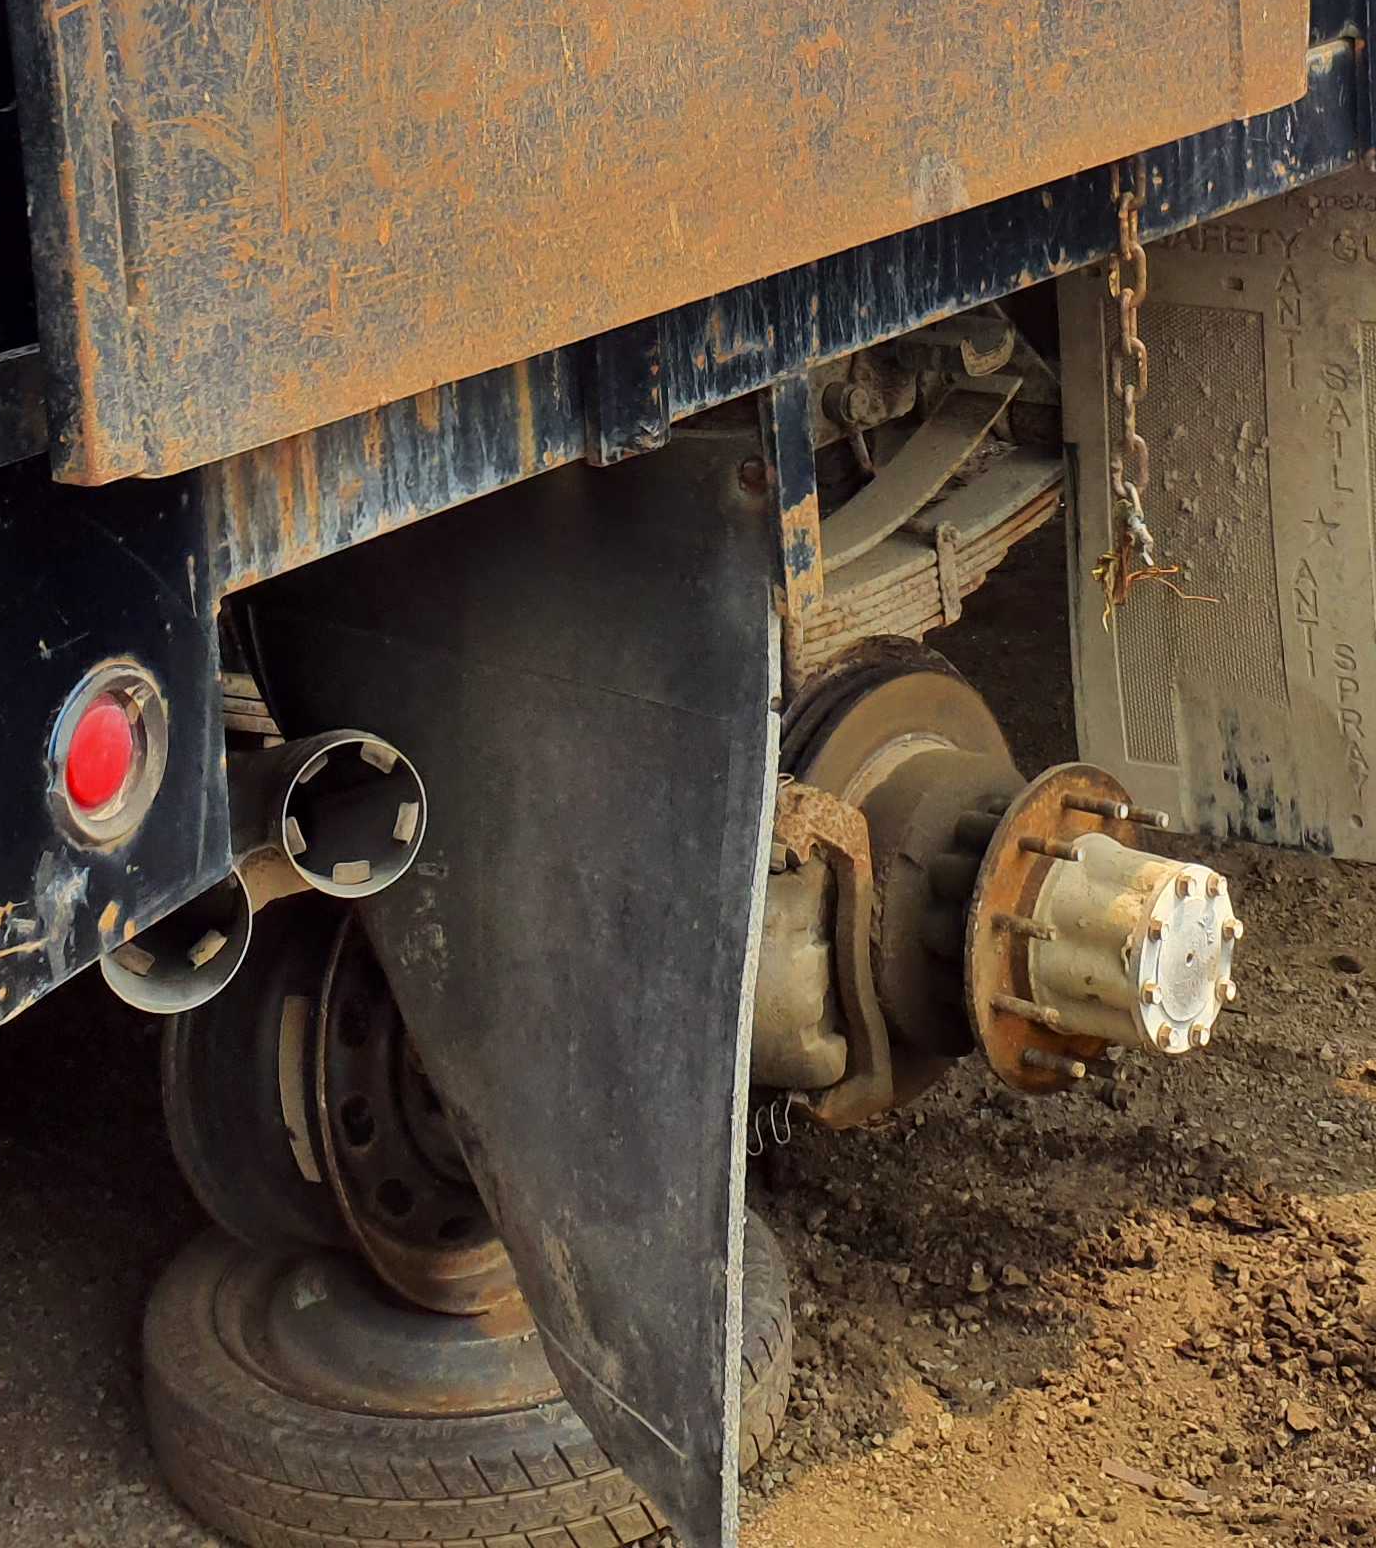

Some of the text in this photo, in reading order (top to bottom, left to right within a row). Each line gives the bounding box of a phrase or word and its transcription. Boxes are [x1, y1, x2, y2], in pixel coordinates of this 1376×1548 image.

[1275, 265, 1355, 493] ANTI SAIL
[1293, 558, 1370, 799] ANTI SPRAY
